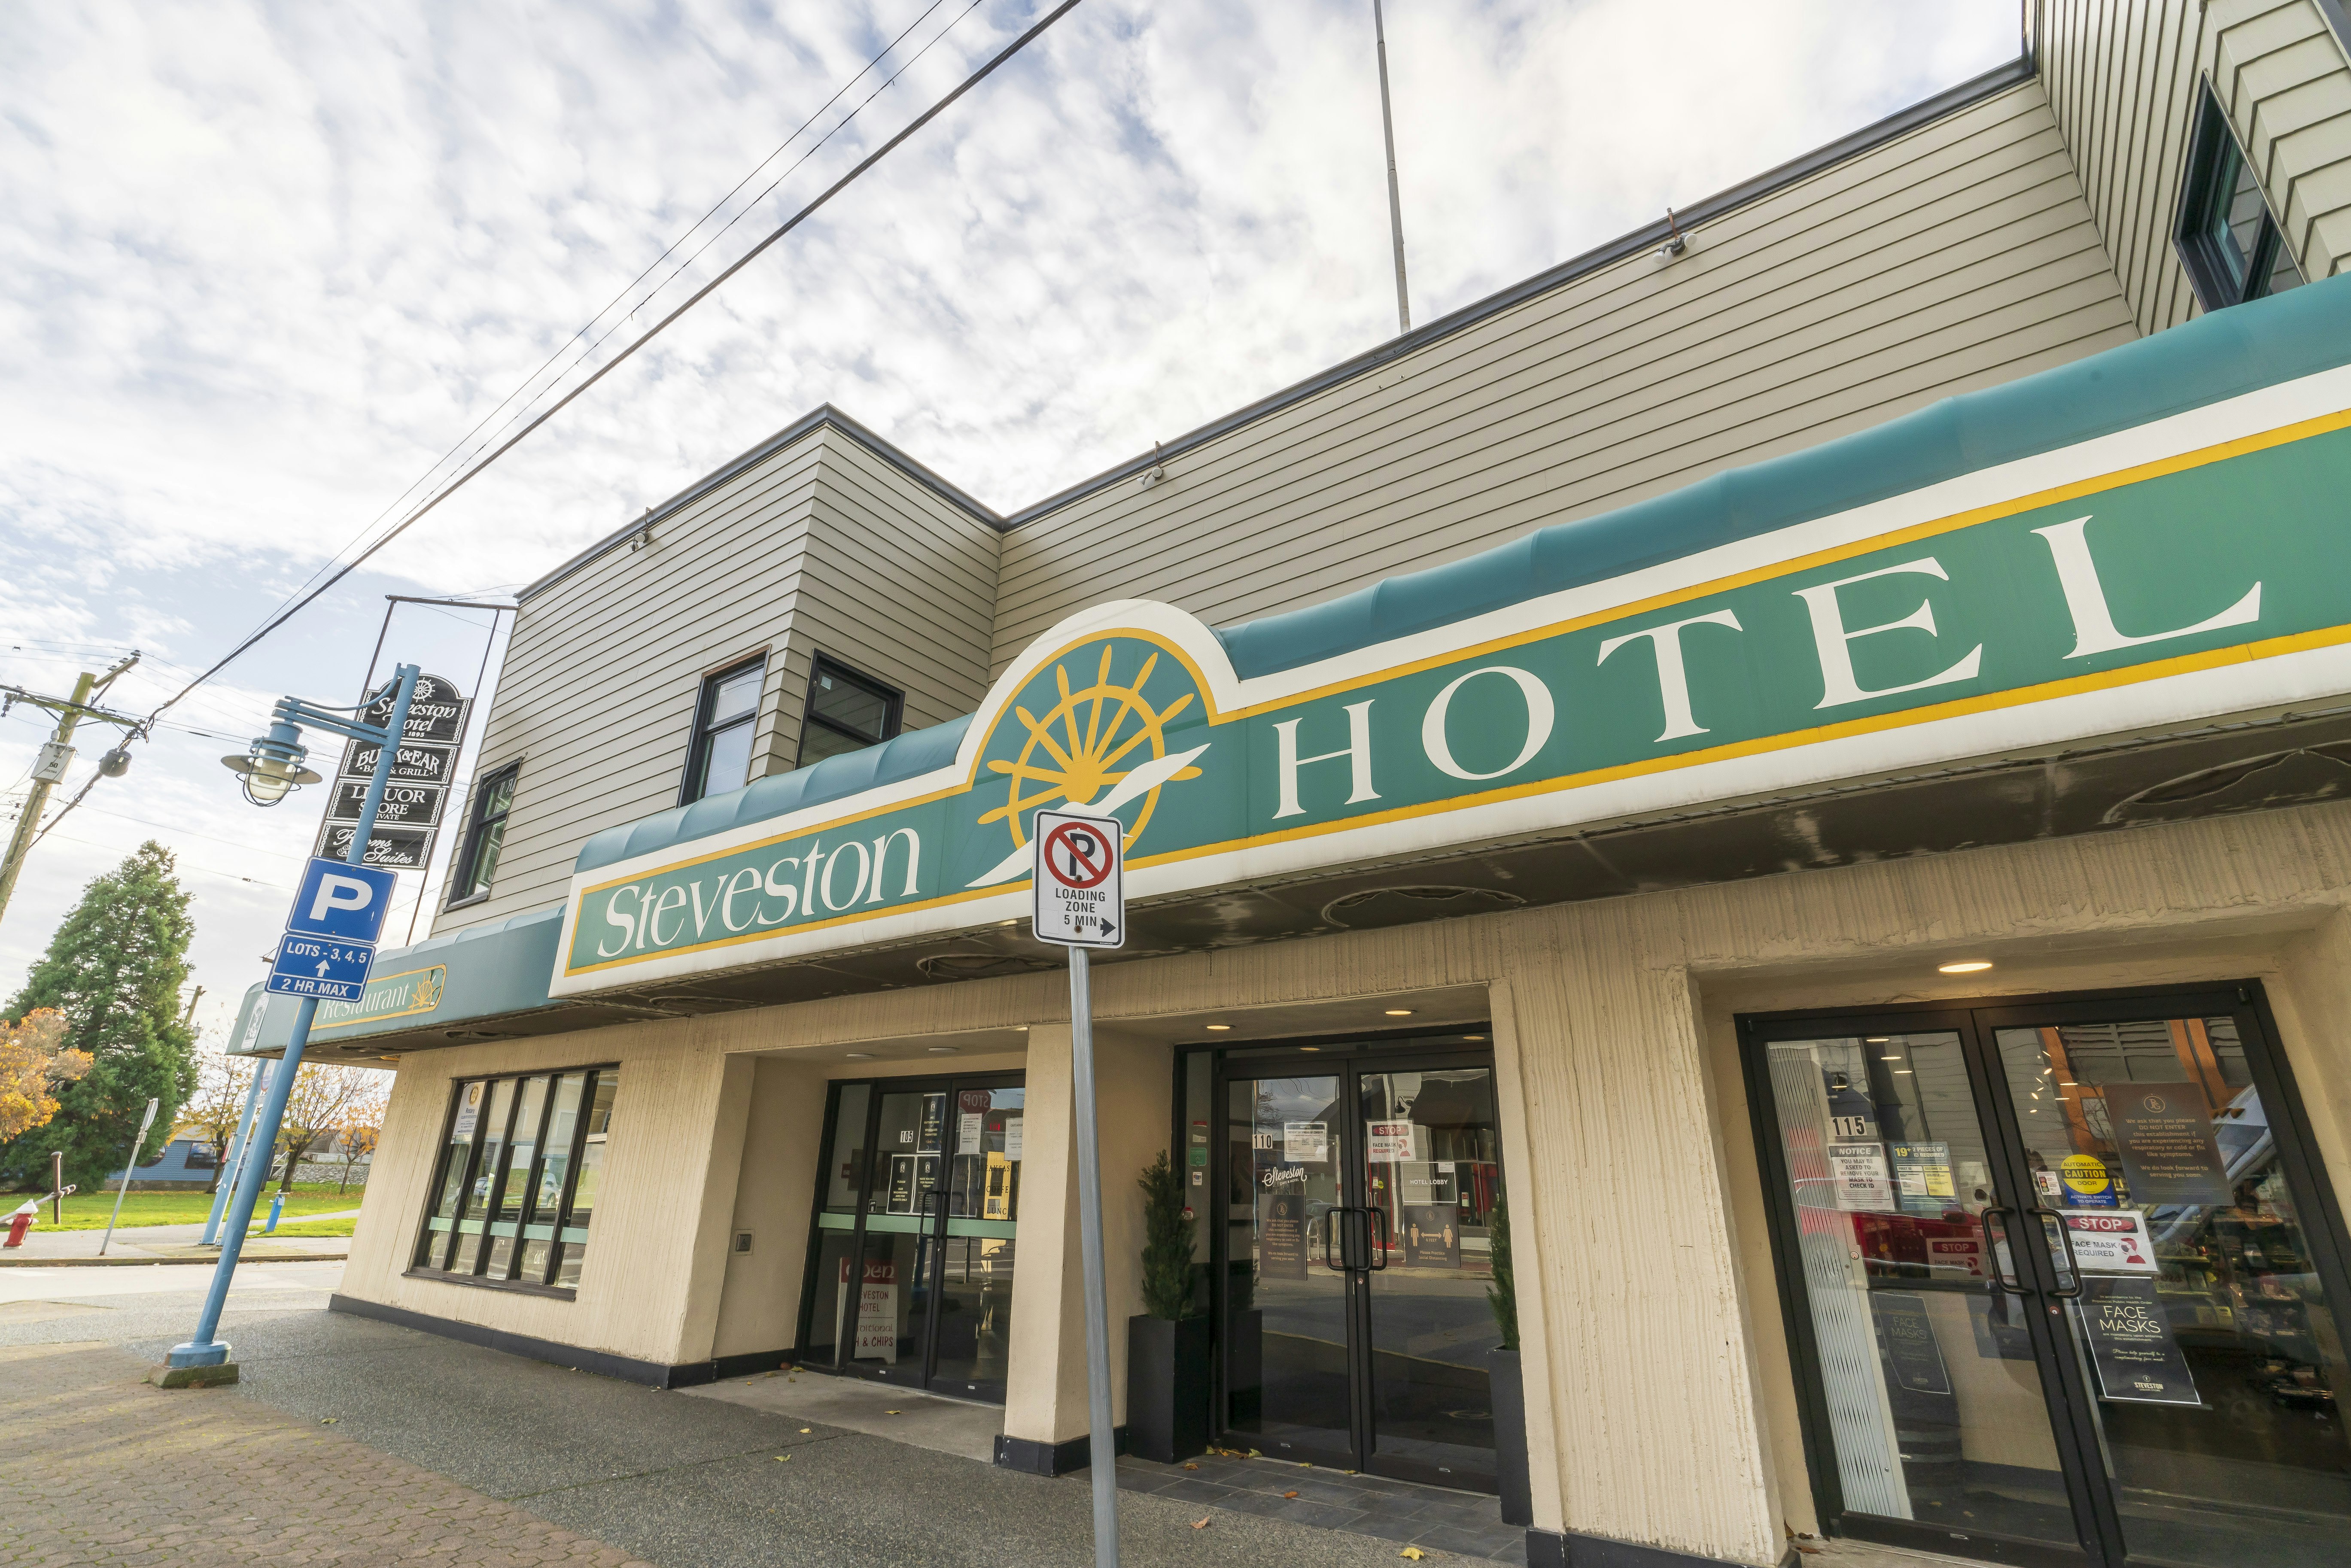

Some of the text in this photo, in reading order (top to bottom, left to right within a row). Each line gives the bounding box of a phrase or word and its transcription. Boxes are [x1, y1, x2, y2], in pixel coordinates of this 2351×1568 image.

[1271, 514, 2263, 821] HOTEL
[372, 697, 456, 718] Steston
[398, 767, 429, 777] GRILL
[350, 785, 425, 803] LIUOR
[359, 801, 409, 815] SORE
[333, 829, 392, 847] Rms
[363, 846, 413, 864] Suites
[309, 873, 373, 921] P
[597, 827, 920, 957] Steveston
[1055, 887, 1105, 902] LOADING
[1065, 901, 1095, 913] ZONE
[1064, 915, 1097, 927] 5 MIN
[287, 942, 320, 957] LOTS
[359, 952, 367, 963] 5
[281, 978, 350, 997] 2 HR MAX
[322, 982, 410, 1020] Restaurant
[1833, 1117, 1865, 1135] 115
[902, 1131, 912, 1142] 105
[1254, 1135, 1271, 1149] 110
[1262, 1166, 1307, 1186] Steveston
[2079, 1218, 2122, 1230] STOP
[1941, 1243, 1969, 1252] STOP
[861, 1291, 889, 1300] VESTON
[2104, 1306, 2148, 1319] FACE
[1893, 1316, 1918, 1328] FACE
[2099, 1319, 2161, 1333] MASKS
[1891, 1327, 1927, 1339] MASKS
[871, 1336, 894, 1347] CHIPS
